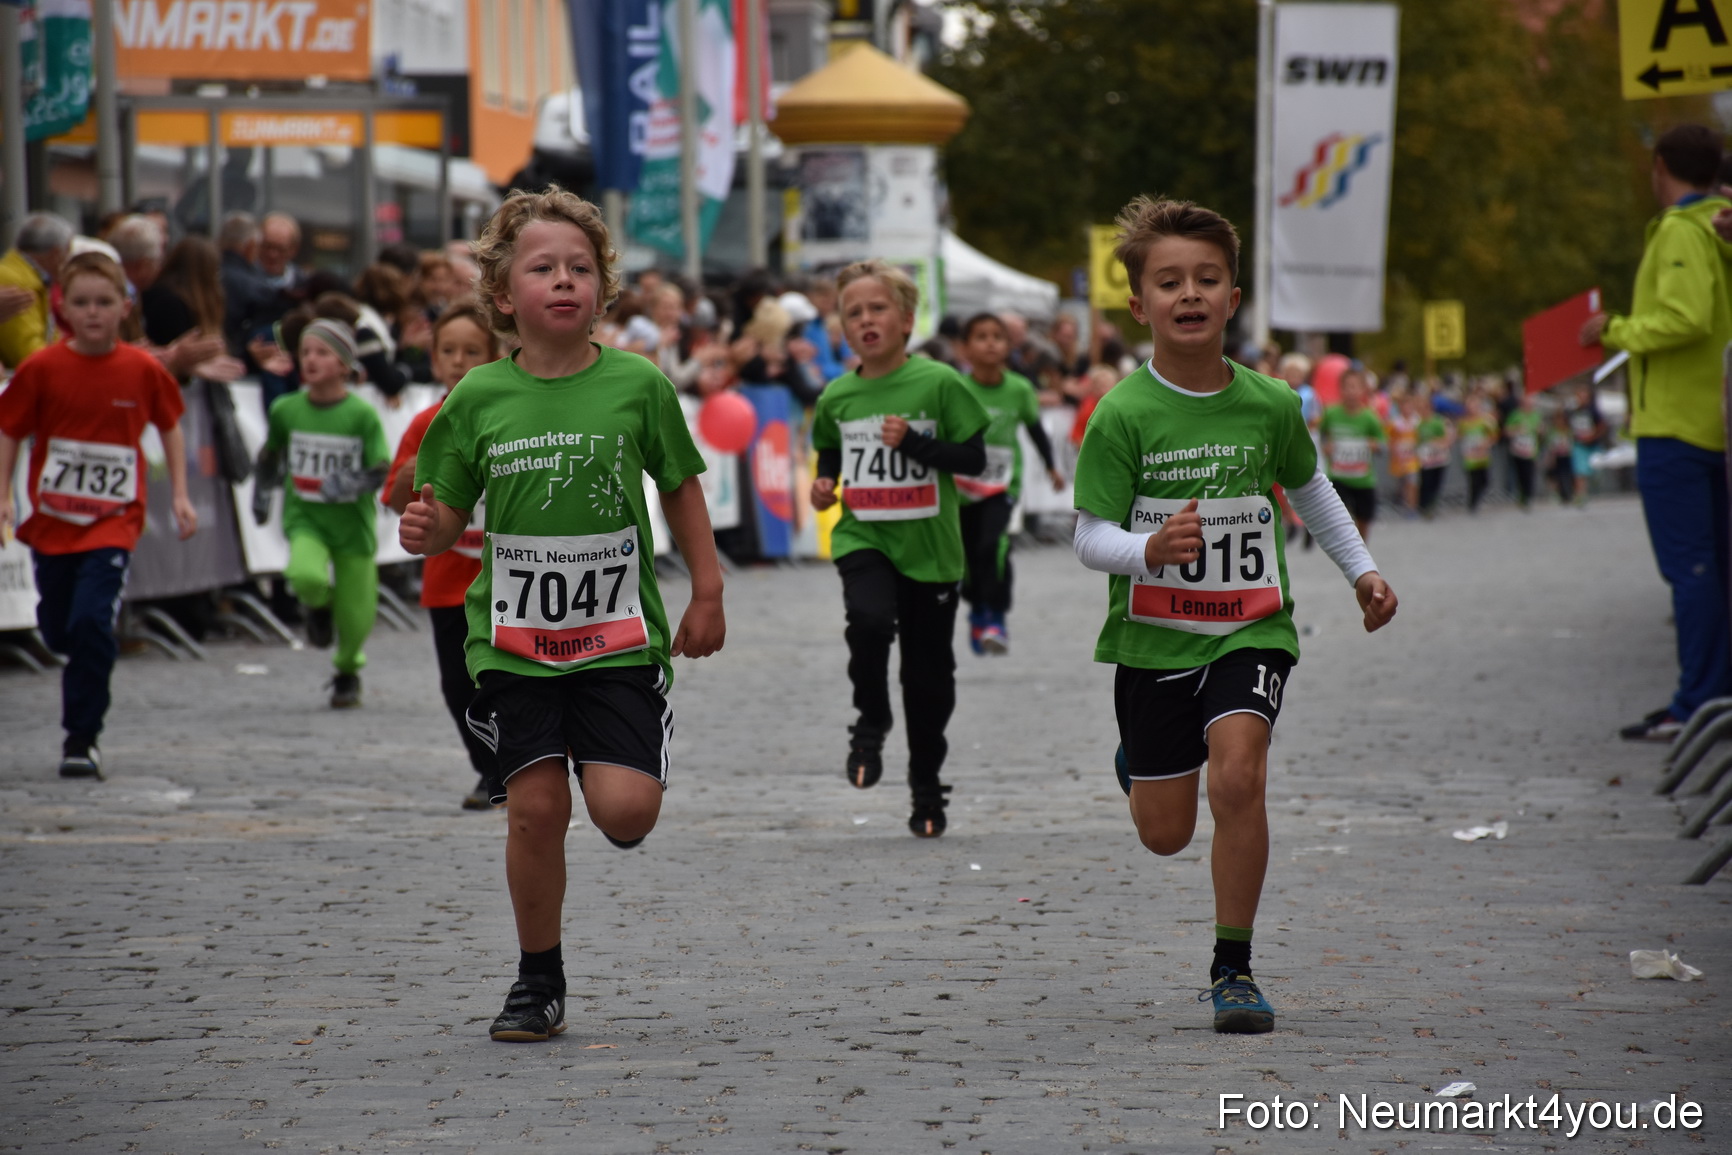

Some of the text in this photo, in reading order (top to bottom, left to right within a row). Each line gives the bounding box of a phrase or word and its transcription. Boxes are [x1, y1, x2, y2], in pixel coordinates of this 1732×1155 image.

[1650, 0, 1729, 52] A
[1284, 55, 1387, 85] swn
[488, 431, 583, 458] Neumarkter
[1142, 443, 1237, 467] Neumarkter
[490, 452, 562, 478] Stadtlauf
[53, 460, 128, 497] 7132
[1201, 512, 1253, 526] eumarkt
[496, 546, 617, 563] PARTL Neumarkt
[1154, 531, 1265, 583] 015
[1266, 575, 1273, 584] K
[509, 564, 628, 623] 7047
[1170, 594, 1244, 617] Lennart
[498, 615, 505, 624] 4
[627, 606, 634, 615] K
[534, 634, 606, 656] Hannes
[1252, 664, 1282, 710] 10
